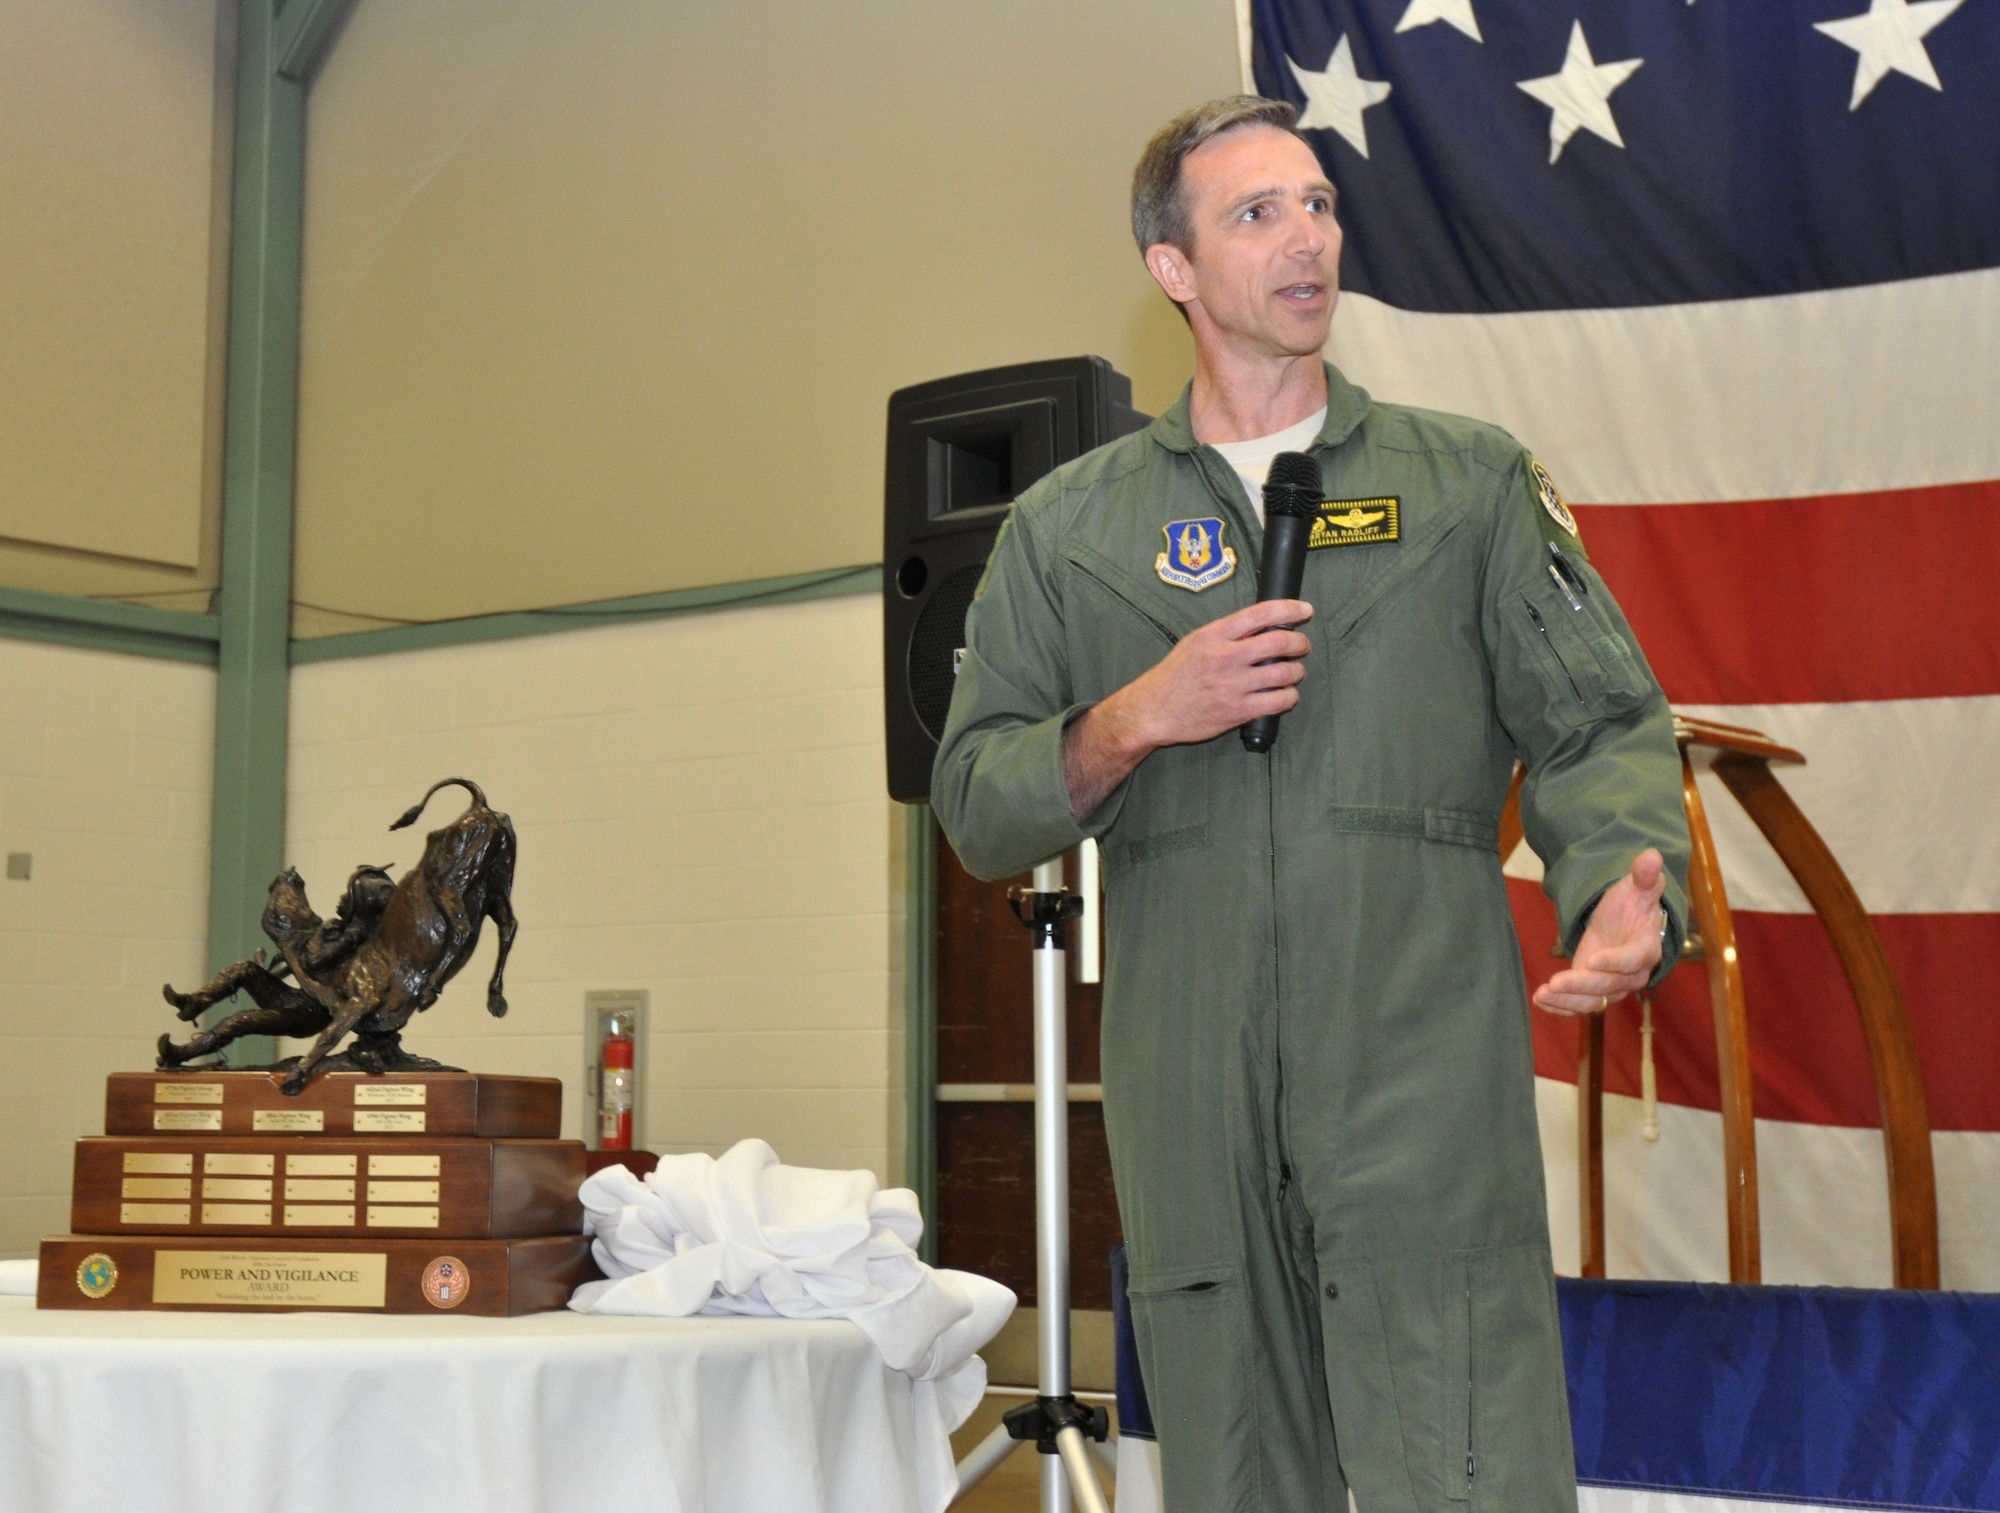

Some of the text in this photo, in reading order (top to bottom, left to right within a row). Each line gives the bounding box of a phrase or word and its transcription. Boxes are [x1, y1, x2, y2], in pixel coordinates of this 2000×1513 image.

[1309, 526, 1380, 541] BRYAN RADLIFF
[180, 1268, 359, 1282] POWER AND VIGILANCE
[247, 1282, 290, 1292] AWARD
